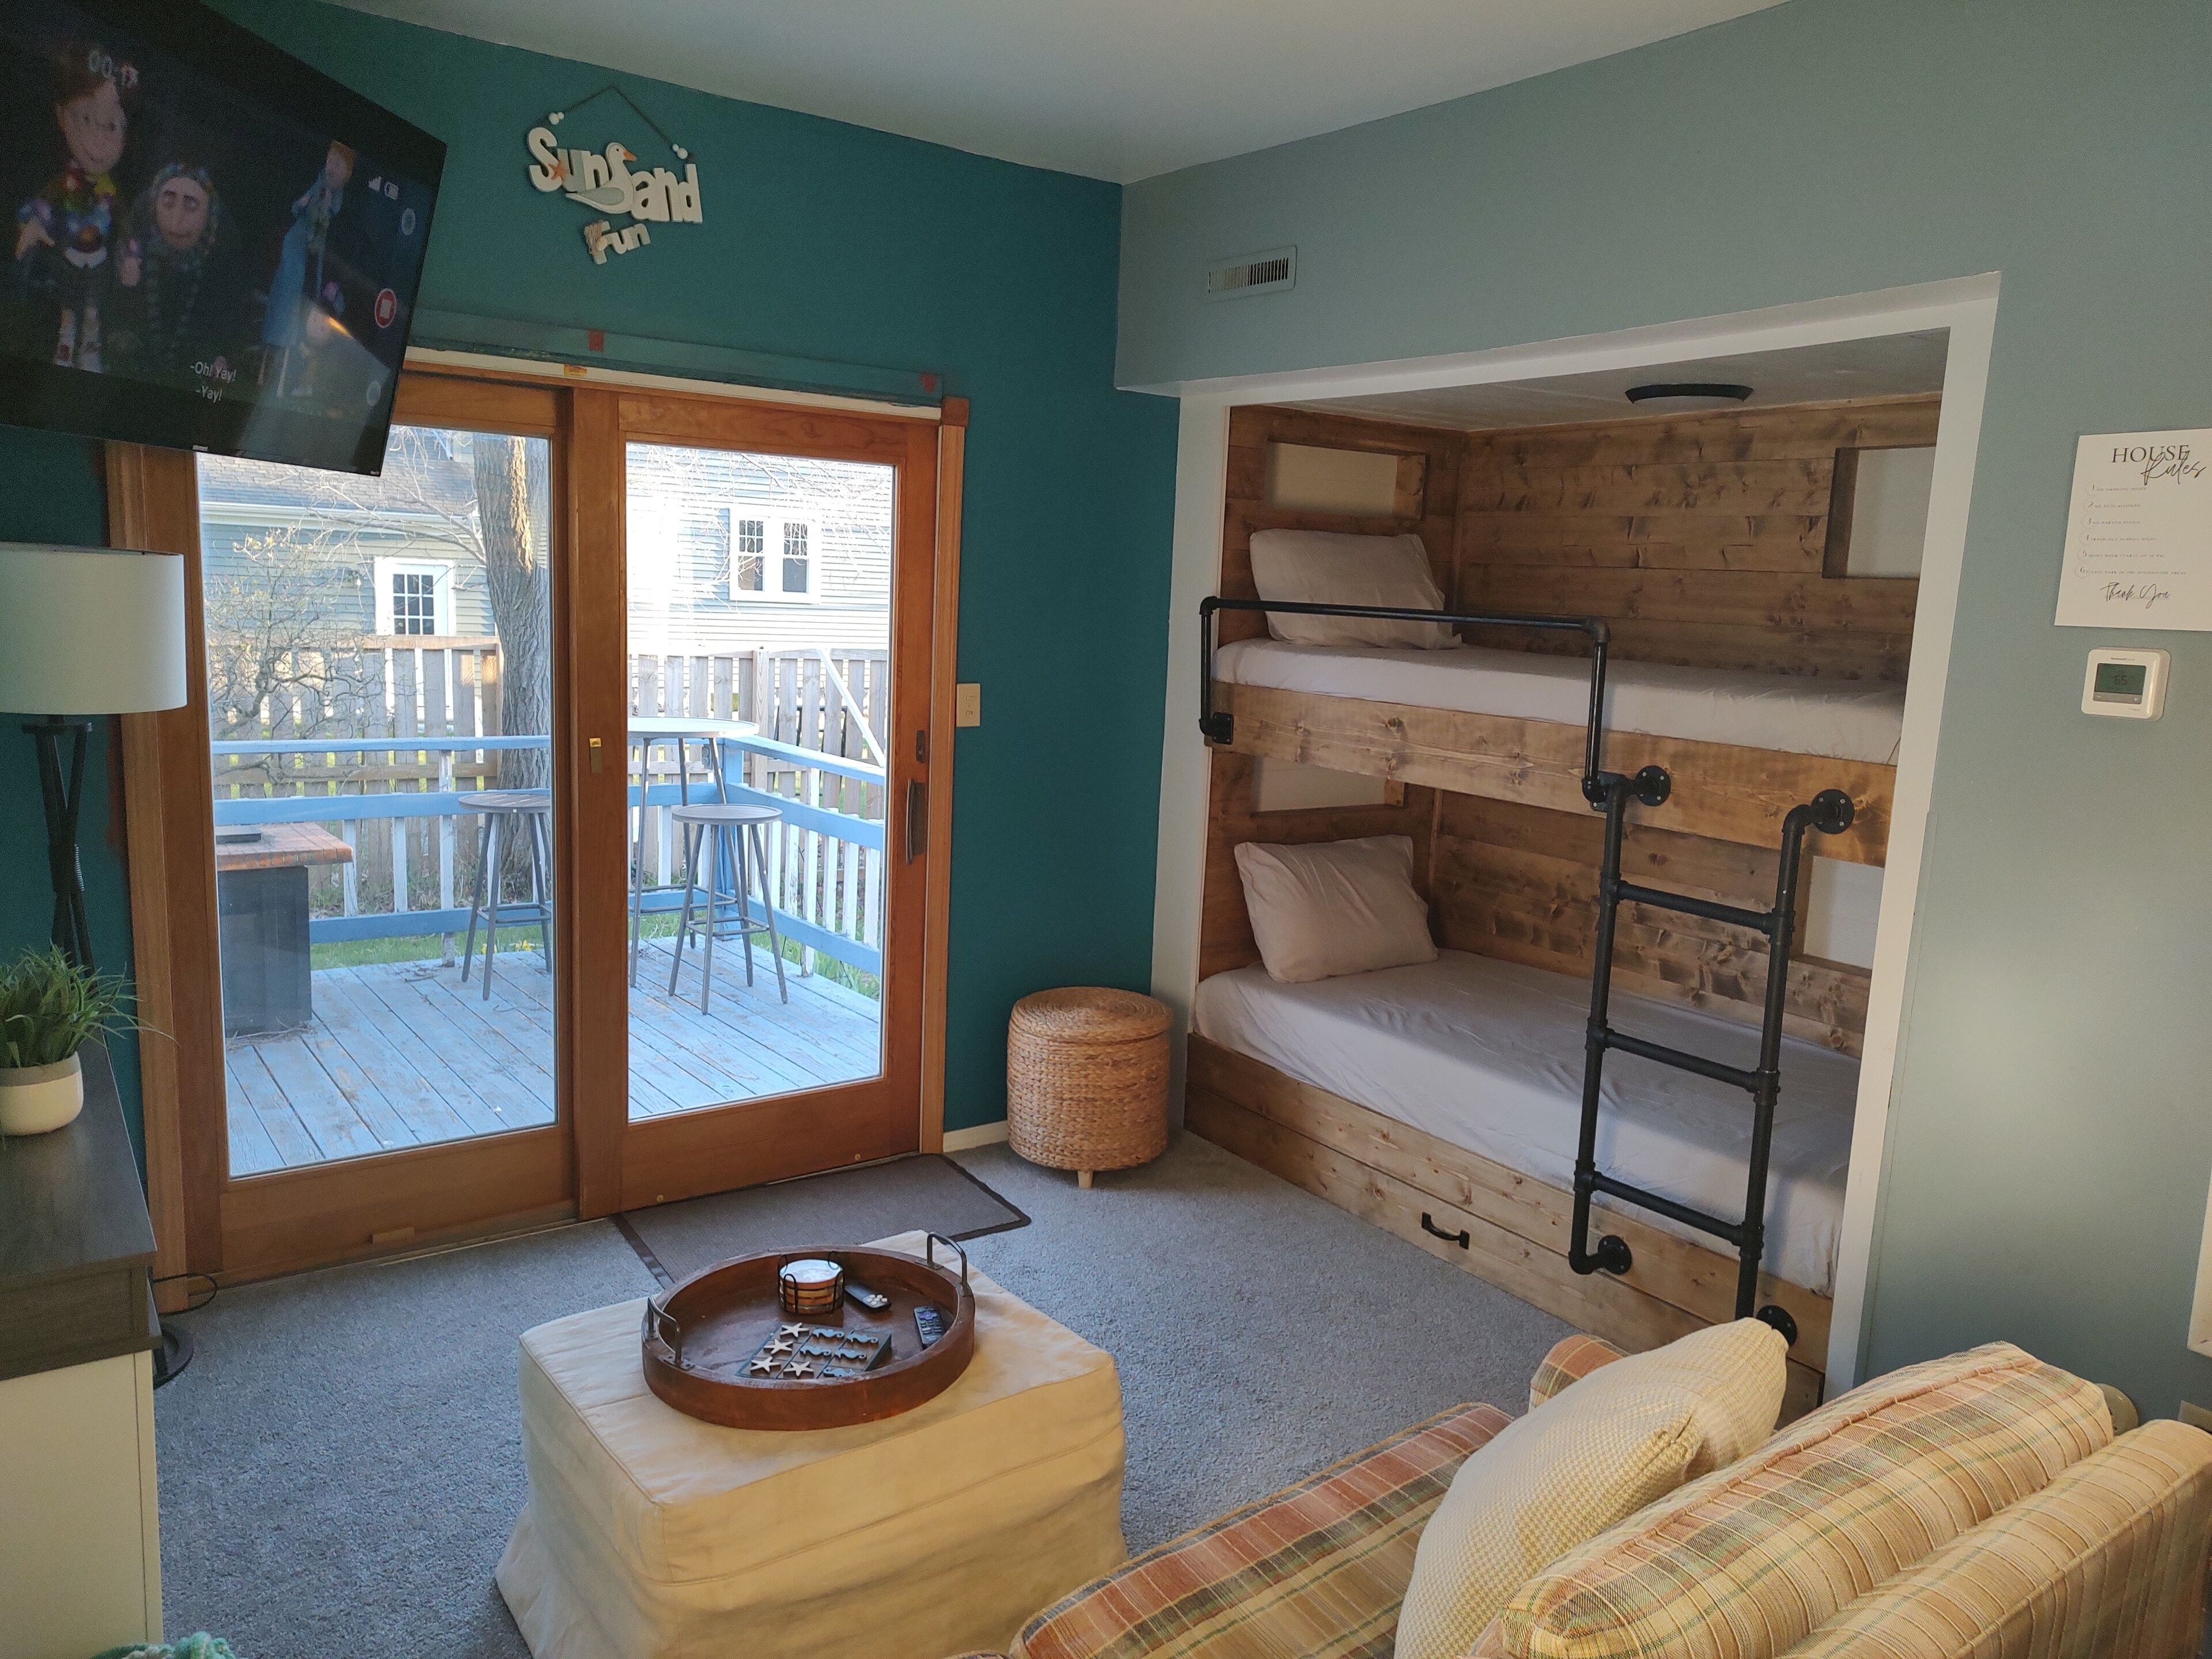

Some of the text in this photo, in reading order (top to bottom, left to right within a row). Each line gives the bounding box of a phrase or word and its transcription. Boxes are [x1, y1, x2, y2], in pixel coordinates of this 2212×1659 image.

[583, 220, 651, 265] Fun
[216, 366, 237, 384] Yay!
[195, 385, 223, 404] -Yay!
[2112, 445, 2190, 463] HOUSE
[2141, 450, 2207, 486] Rules
[2100, 582, 2171, 609] Thank You
